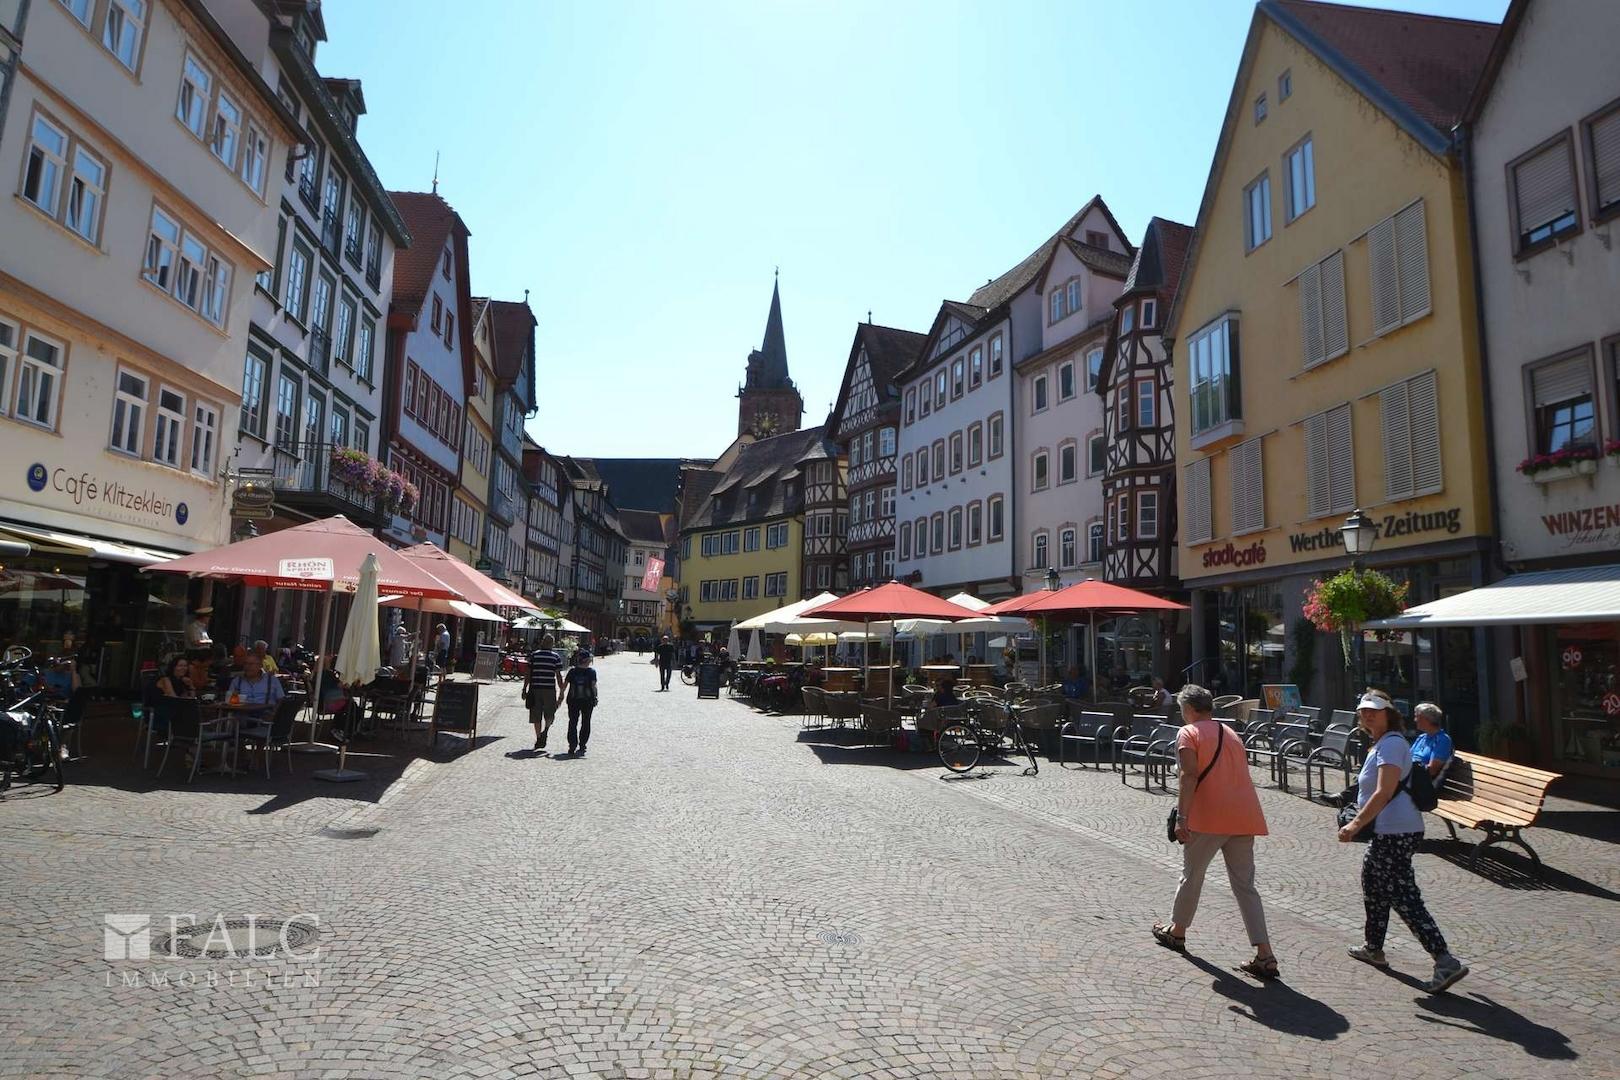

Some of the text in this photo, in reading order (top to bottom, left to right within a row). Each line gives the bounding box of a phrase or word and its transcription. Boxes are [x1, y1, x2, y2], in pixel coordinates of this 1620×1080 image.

[53, 467, 98, 505] Café
[103, 481, 173, 518] Klitzeklein
[1202, 539, 1267, 569] stadtcafé
[1289, 507, 1462, 554] Werther Zeitung
